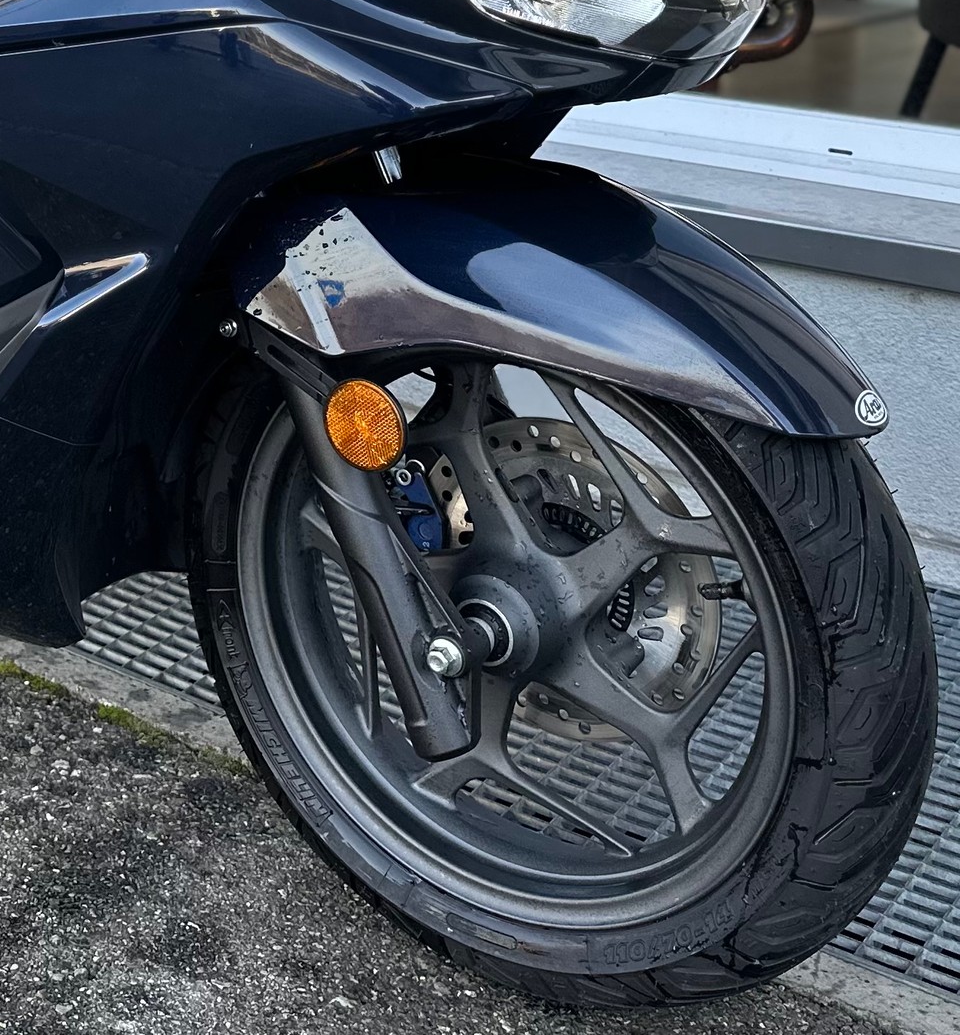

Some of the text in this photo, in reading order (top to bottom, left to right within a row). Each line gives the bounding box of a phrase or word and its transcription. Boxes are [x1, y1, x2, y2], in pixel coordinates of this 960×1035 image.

[862, 398, 882, 421] Ara
[246, 700, 333, 827] MICHELIN
[604, 900, 734, 965] 110/70-14
